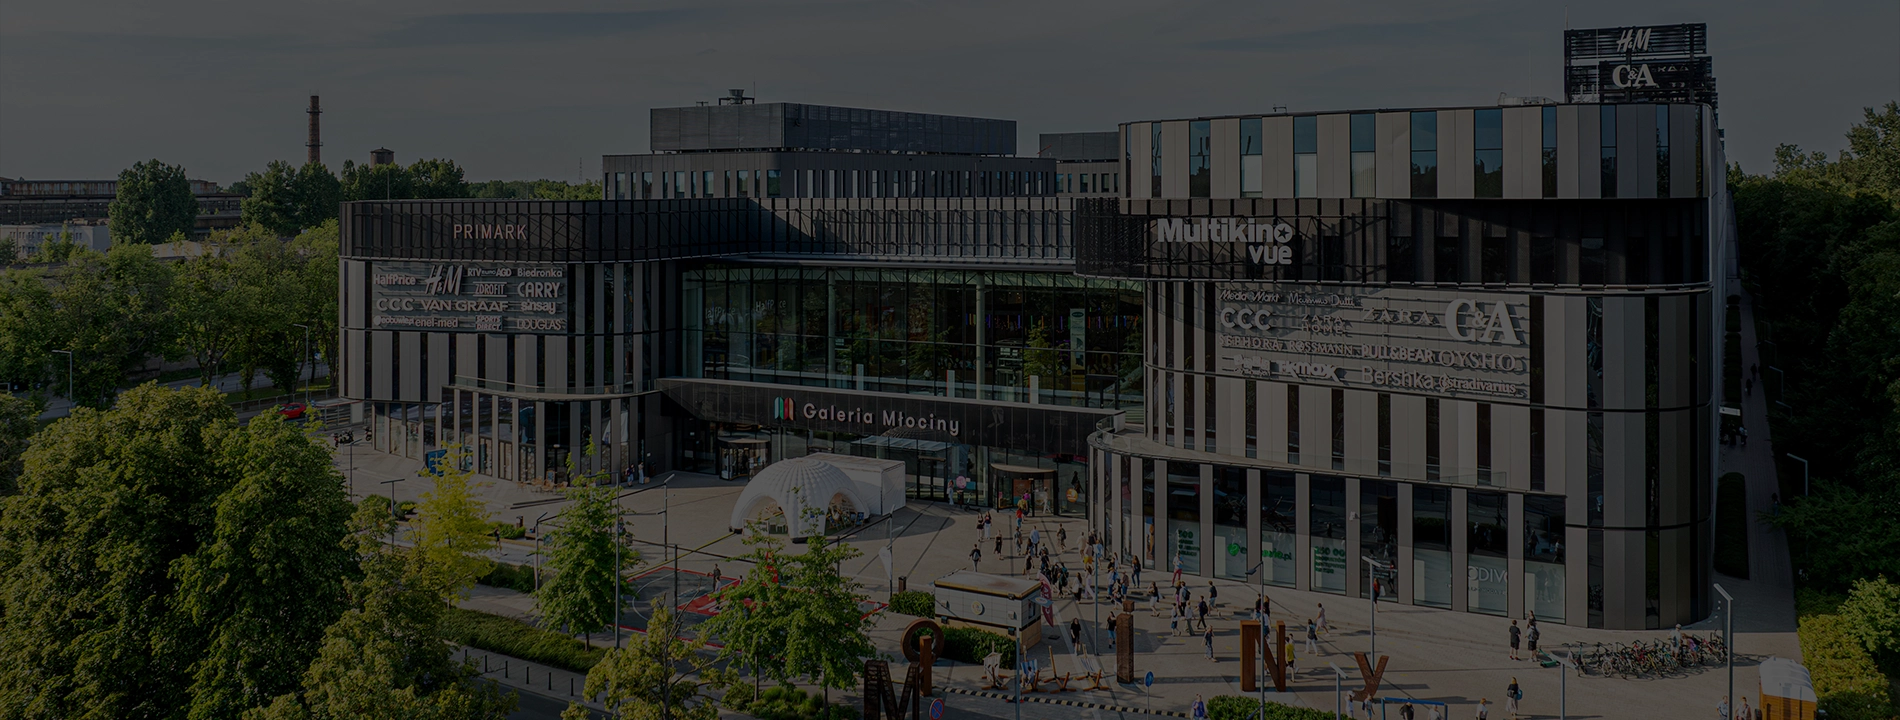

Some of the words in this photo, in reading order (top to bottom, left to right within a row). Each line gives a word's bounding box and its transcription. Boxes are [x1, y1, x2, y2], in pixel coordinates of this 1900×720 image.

[1616, 28, 1652, 53] H&M
[1612, 63, 1657, 88] C&A
[453, 224, 527, 239] PRIMARK
[1157, 218, 1293, 243] Multikino
[1248, 245, 1293, 265] vue
[373, 274, 416, 286] HalfPrice
[424, 264, 464, 296] H&M
[467, 268, 481, 276] RTV
[496, 268, 512, 277] AGD
[517, 268, 563, 277] Biedronka
[475, 284, 505, 295] ZDROFIT
[517, 282, 560, 297] CARRY
[376, 298, 414, 311] CCC
[421, 300, 452, 311] VAN
[455, 300, 509, 312] GRAAF
[415, 317, 458, 328] enel-med
[1220, 307, 1272, 331] CCC
[1302, 314, 1343, 324] ZARA
[1363, 307, 1434, 325] ZARA
[1445, 298, 1524, 345] C&A
[517, 318, 561, 330] DOUGLAS
[1301, 323, 1344, 334] HOME
[1219, 334, 1280, 350] SEPHORA
[1289, 340, 1353, 354] ROSSMANN
[1361, 344, 1434, 363] PULL&BEAR
[1438, 350, 1516, 371] OYSHO
[1361, 365, 1434, 389] Bershka
[803, 403, 873, 424] Galeria
[882, 410, 960, 436] Młociny
